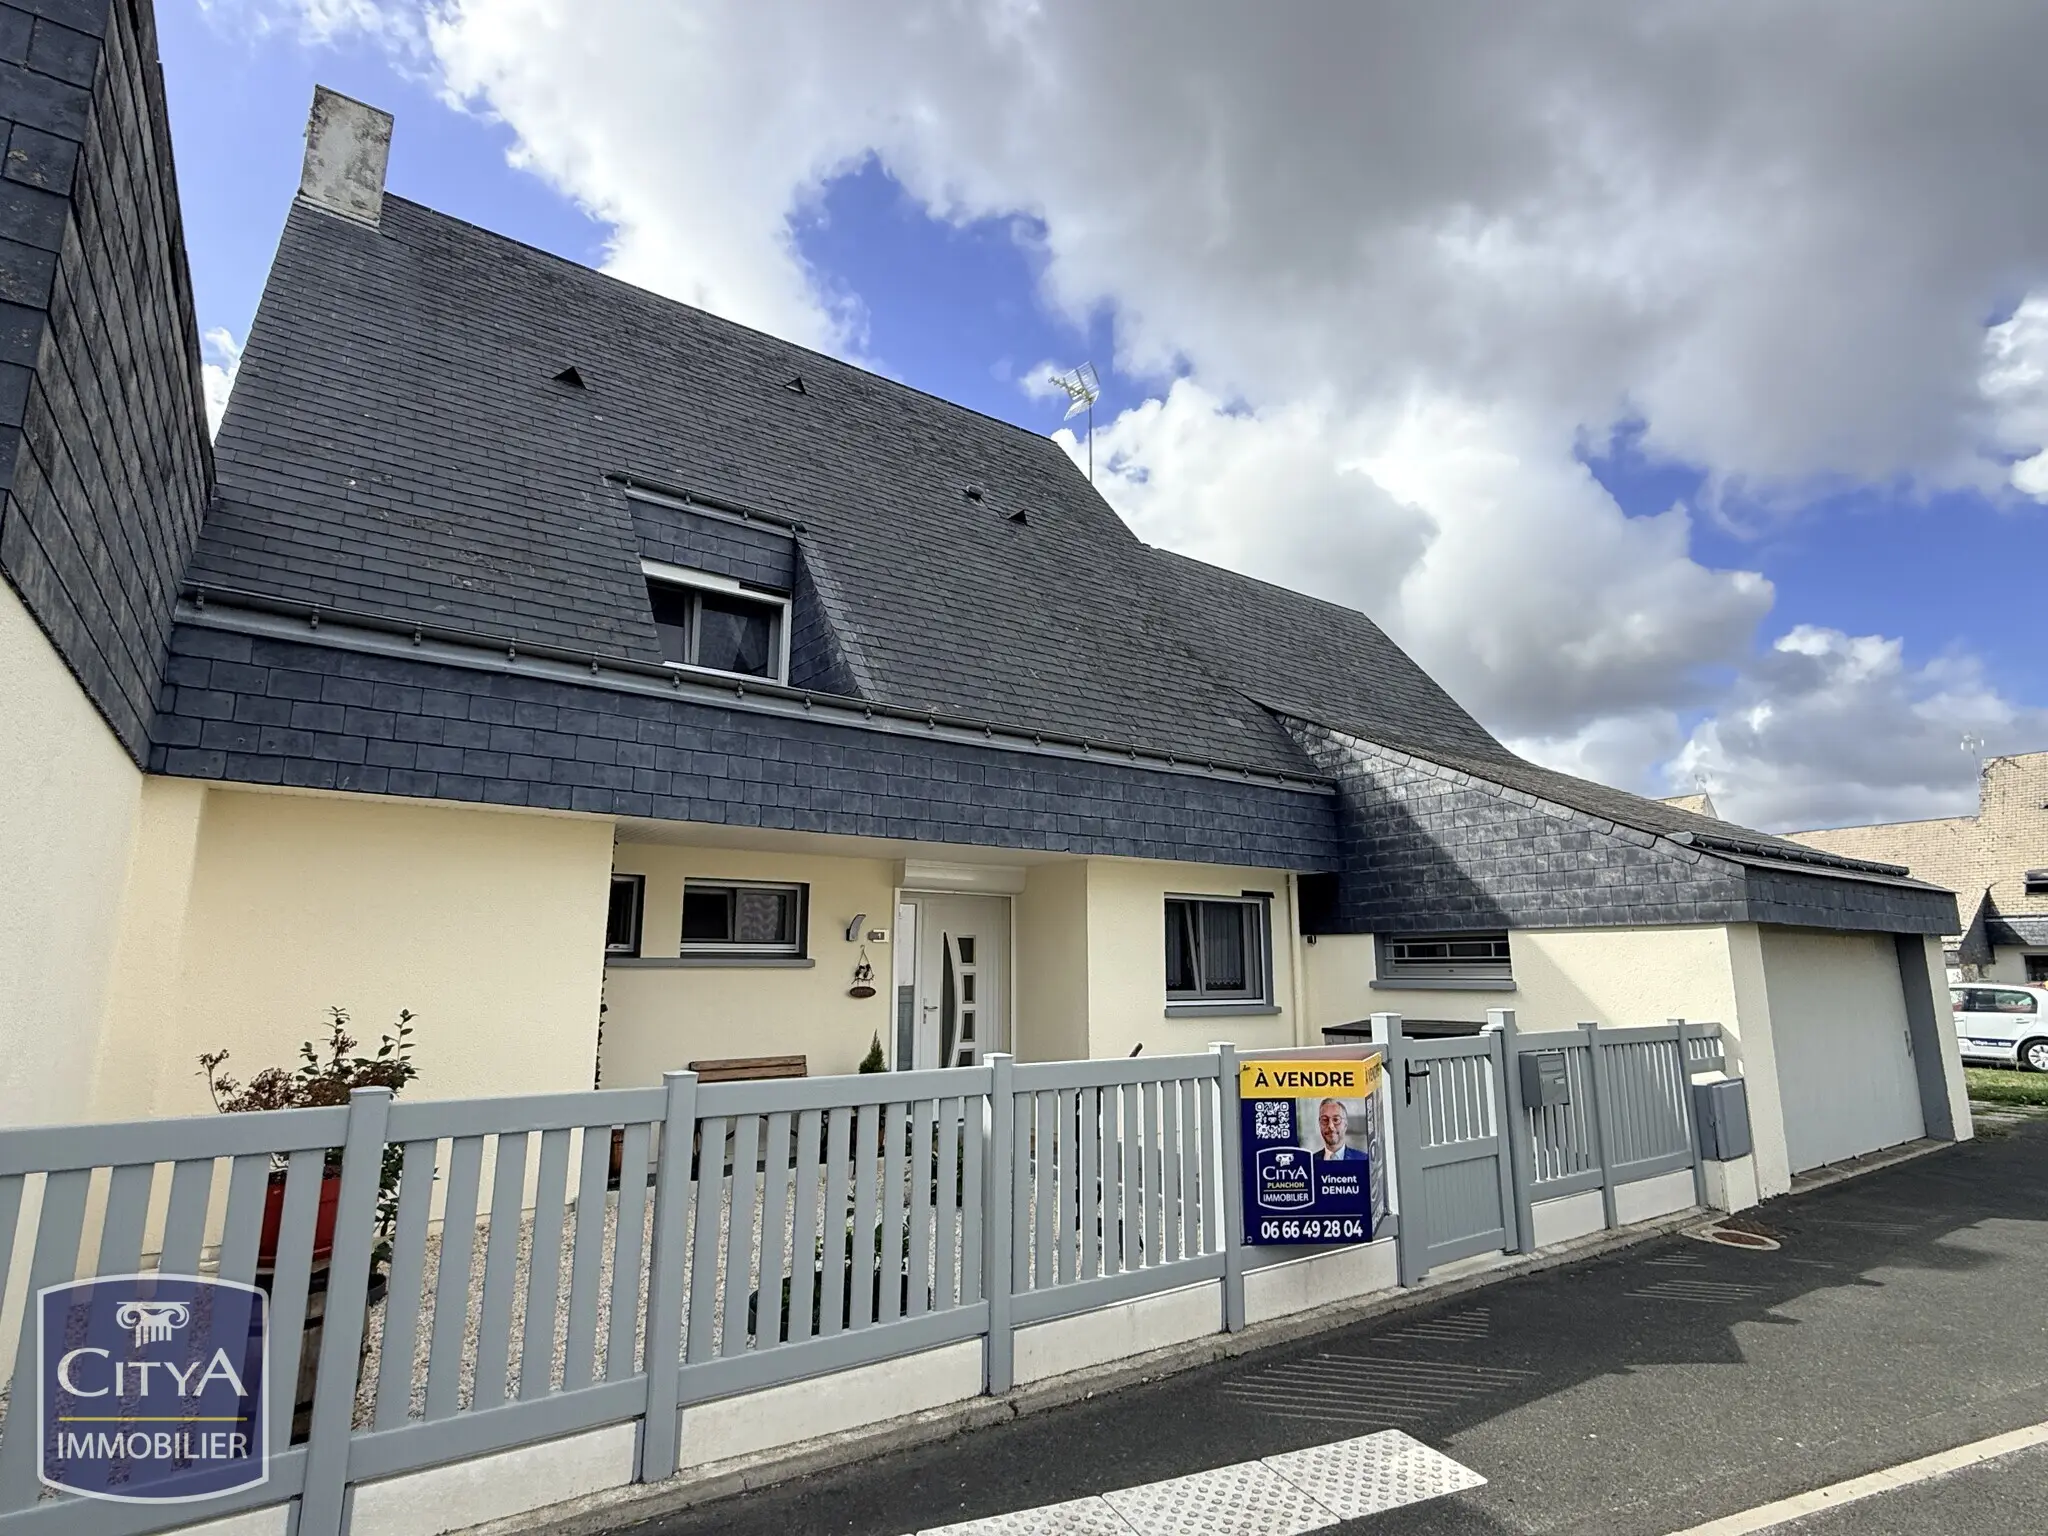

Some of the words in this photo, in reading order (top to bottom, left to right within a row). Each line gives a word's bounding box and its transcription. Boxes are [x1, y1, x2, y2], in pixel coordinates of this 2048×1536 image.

[1254, 1067, 1269, 1087] À
[1274, 1071, 1354, 1087] VENDRE
[1321, 1174, 1357, 1184] Vincent
[1322, 1185, 1359, 1195] DENIAU
[1263, 1193, 1309, 1202] IMMOBILIER
[1261, 1221, 1279, 1239] 06
[1282, 1221, 1299, 1238] 66
[1302, 1220, 1321, 1238] 49
[1323, 1220, 1340, 1237] 28
[1344, 1220, 1363, 1237] 04
